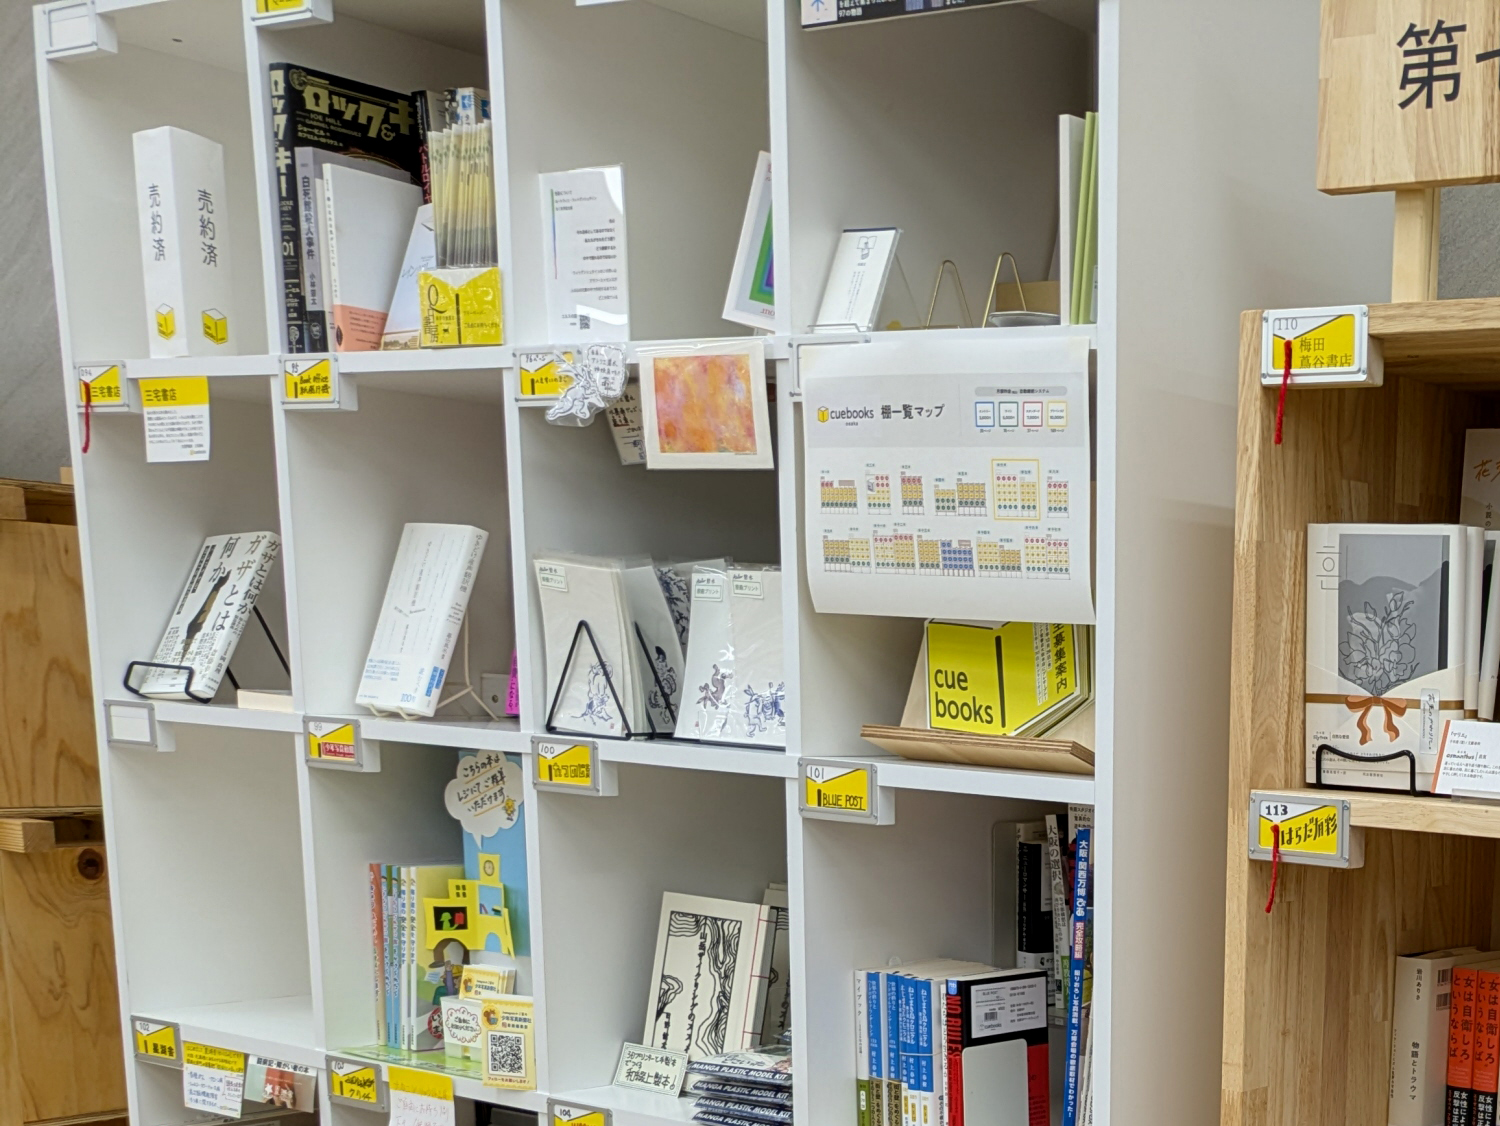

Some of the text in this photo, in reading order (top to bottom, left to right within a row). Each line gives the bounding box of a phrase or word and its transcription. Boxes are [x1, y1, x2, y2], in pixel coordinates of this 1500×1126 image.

[148, 183, 167, 262] 売約済
[196, 188, 219, 268] 売約済
[1299, 337, 1325, 353] 梅田
[830, 403, 946, 421] cuebooks 棚一覧マップ
[208, 536, 241, 583] 何か
[211, 534, 267, 632] ガザとは
[238, 539, 281, 615] ガザとは何か
[934, 668, 968, 691] cue
[934, 691, 995, 725] books
[540, 745, 555, 755] 100
[462, 756, 501, 778] こちらの本は
[810, 766, 825, 780] 101
[822, 793, 864, 810] BLUE POST
[1265, 804, 1289, 816] 113
[950, 994, 962, 1060] NO RULES
[1450, 974, 1461, 1058] というならば
[1475, 976, 1486, 1062] というならば
[692, 1062, 719, 1072] MANGA
[721, 1067, 747, 1075] PLASTIC
[1409, 1041, 1420, 1101] 物語とトラウマ
[695, 1082, 722, 1091] MANGA
[723, 1086, 749, 1095] PLASTIC
[750, 1090, 775, 1098] MODEL
[559, 1108, 572, 1118] 104
[698, 1098, 724, 1108] MANGA
[726, 1102, 752, 1112] PLASTIC
[753, 1107, 777, 1116] MODEL
